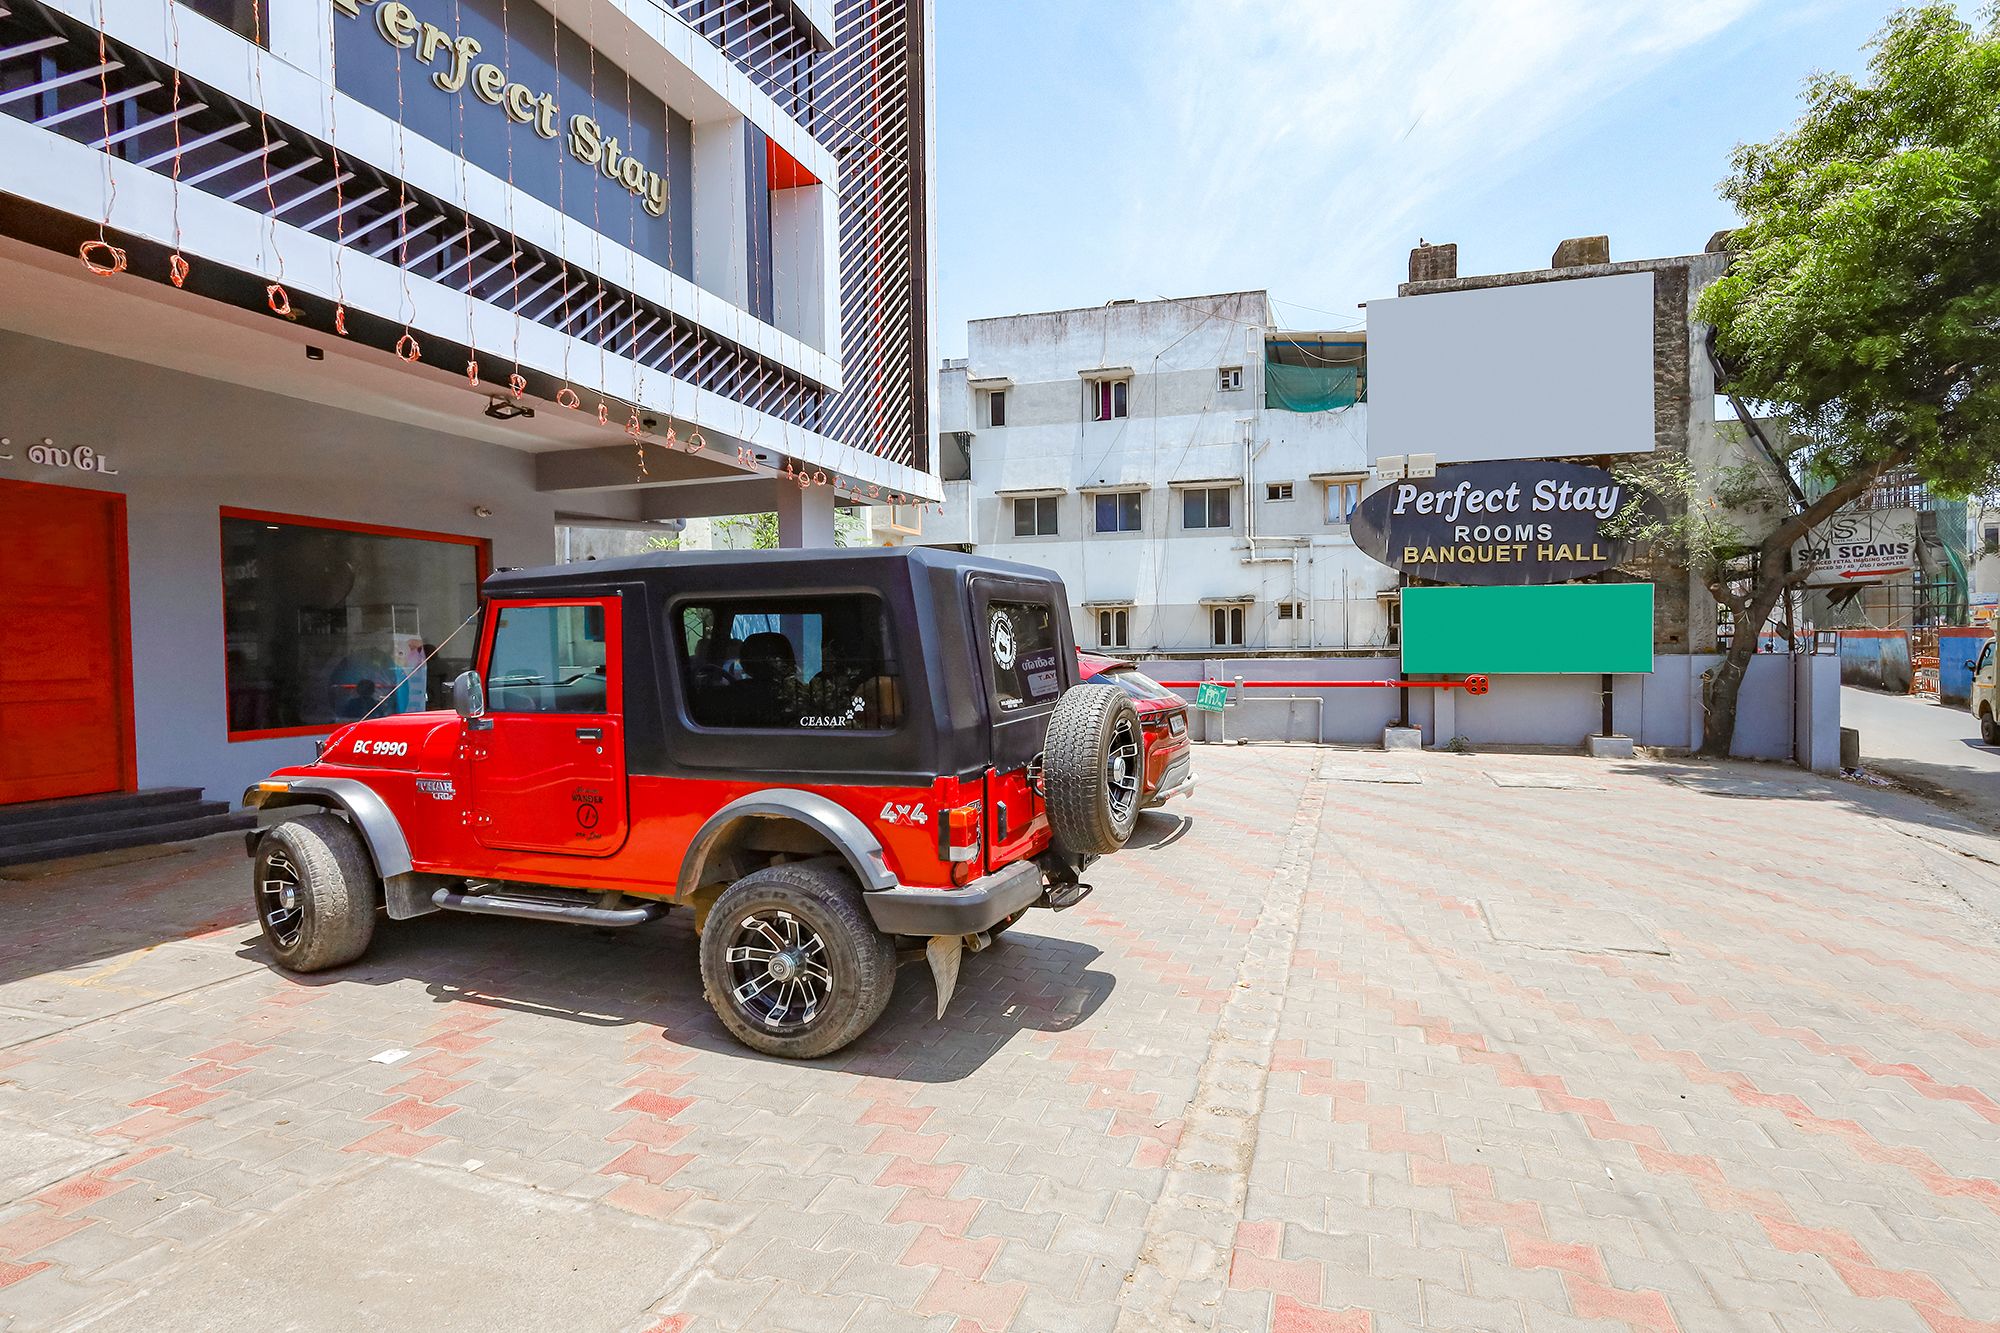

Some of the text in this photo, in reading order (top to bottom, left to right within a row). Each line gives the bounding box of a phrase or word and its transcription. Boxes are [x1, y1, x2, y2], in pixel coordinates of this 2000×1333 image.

[336, 0, 668, 217] erfect Stay
[1393, 479, 1620, 523] Perfect Stay
[1454, 523, 1553, 543] ROOMS
[1403, 543, 1608, 564] BANQUET HALL
[1839, 543, 1909, 559] SCANS
[800, 716, 846, 727] CEASAR
[353, 740, 408, 756] BC 9990
